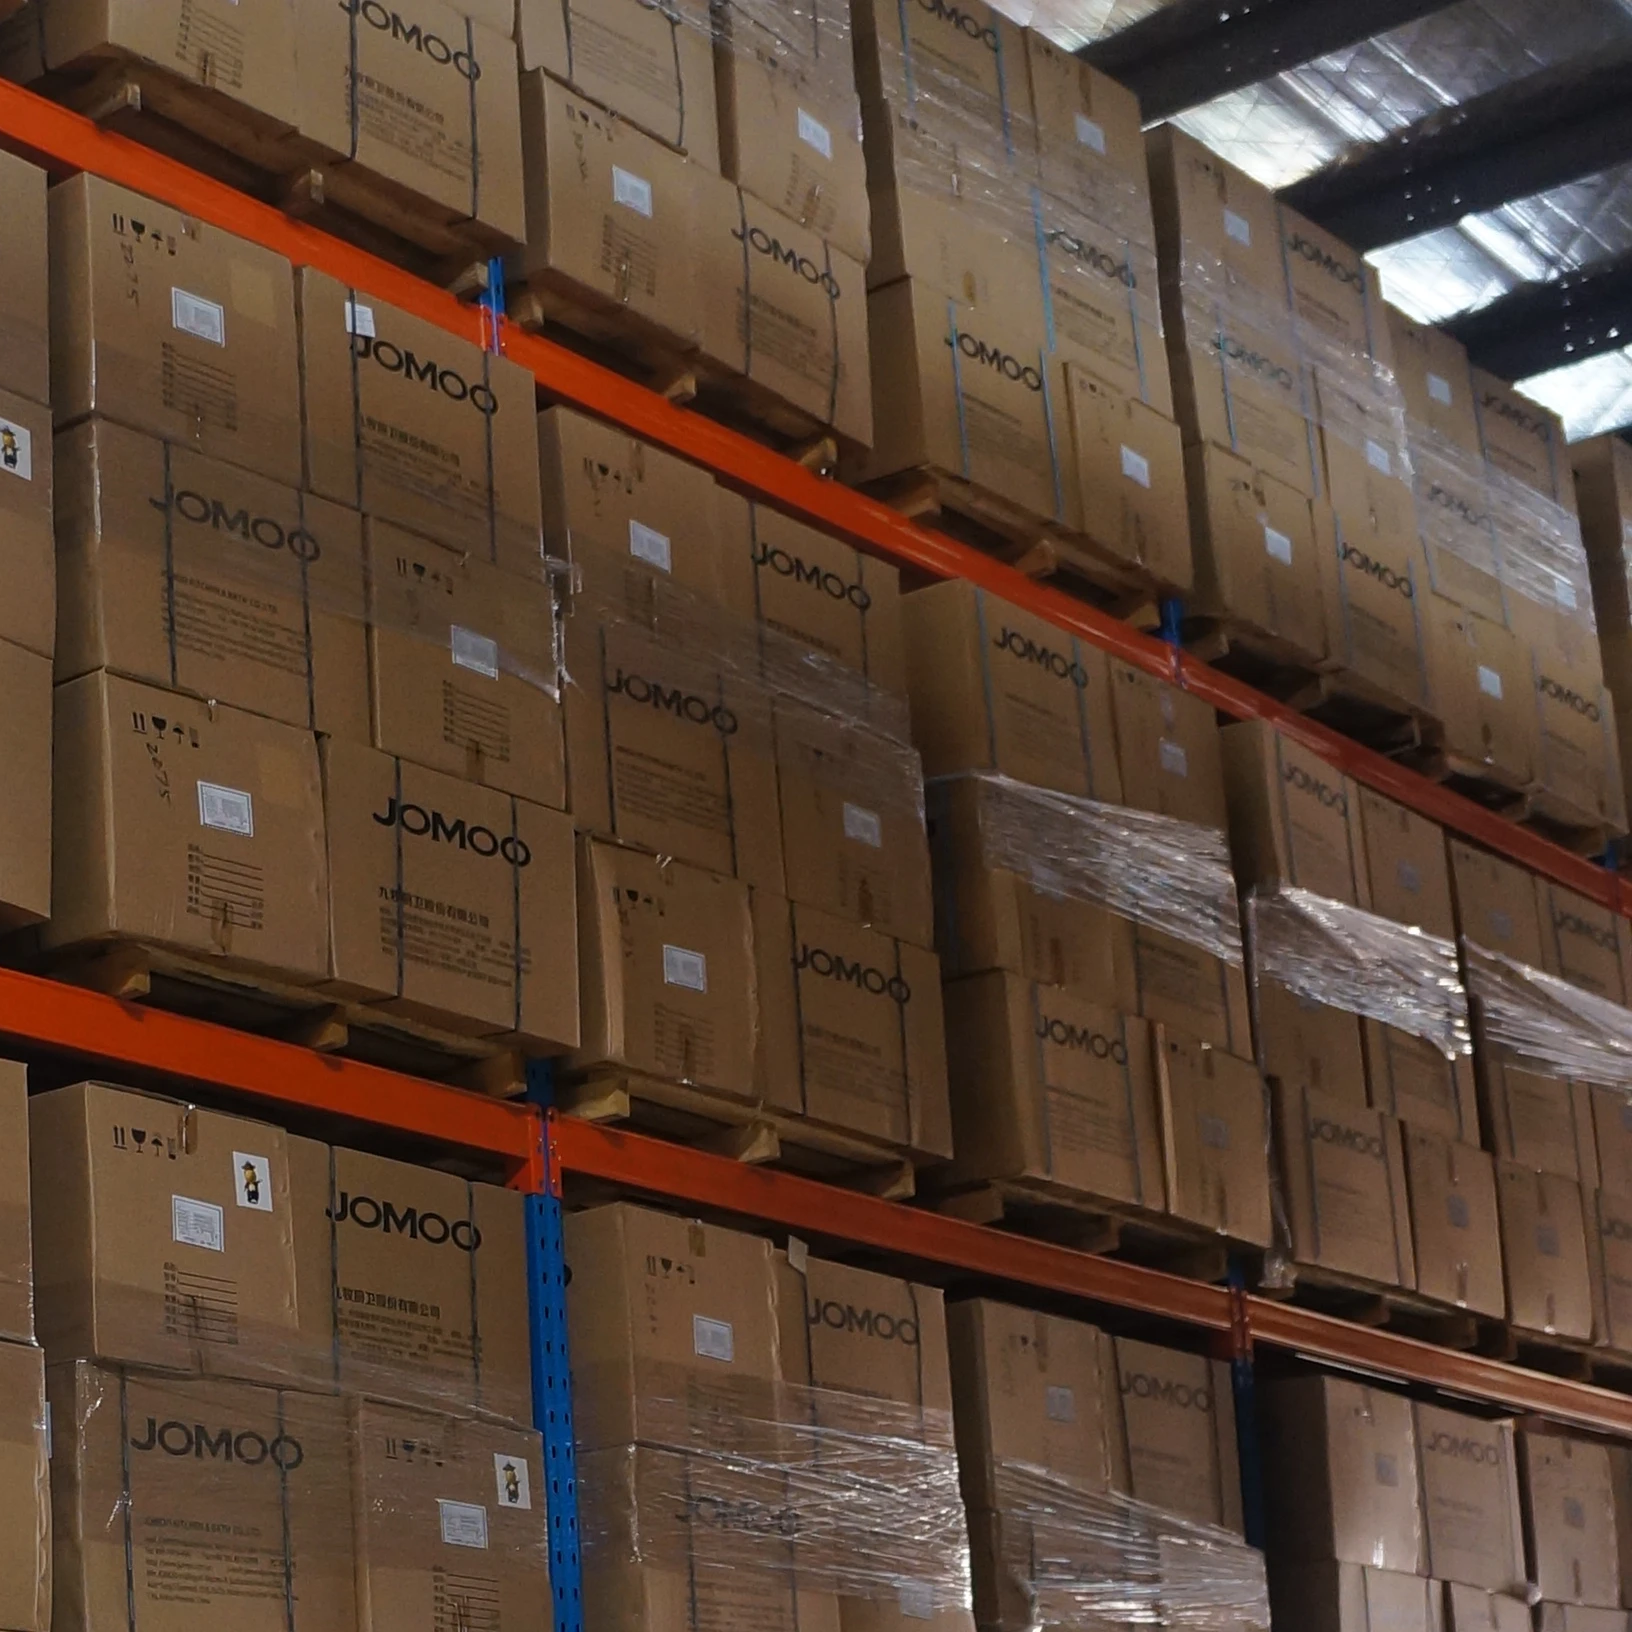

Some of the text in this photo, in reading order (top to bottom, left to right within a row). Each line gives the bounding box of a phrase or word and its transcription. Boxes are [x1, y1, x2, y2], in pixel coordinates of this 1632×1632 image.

[731, 223, 841, 299] JOMOO
[350, 335, 500, 416] JOMOO
[944, 330, 1042, 391] JOMOO
[149, 488, 321, 562] JOMOO
[752, 542, 872, 611] JOMOO
[1338, 541, 1415, 597] JOMOO
[993, 627, 1088, 691] JOMOO
[608, 669, 738, 735] JOMOO
[373, 797, 531, 868] JOMOO
[792, 944, 911, 1003] JOMOO
[1035, 1014, 1127, 1066] JOMOO
[325, 1191, 482, 1252] JOMOO
[336, 1286, 441, 1320] 牧厨卫股份有限公司
[808, 1298, 919, 1346] JOMOO
[1118, 1370, 1211, 1412] JOMOO
[131, 1417, 304, 1471] JOMOO
